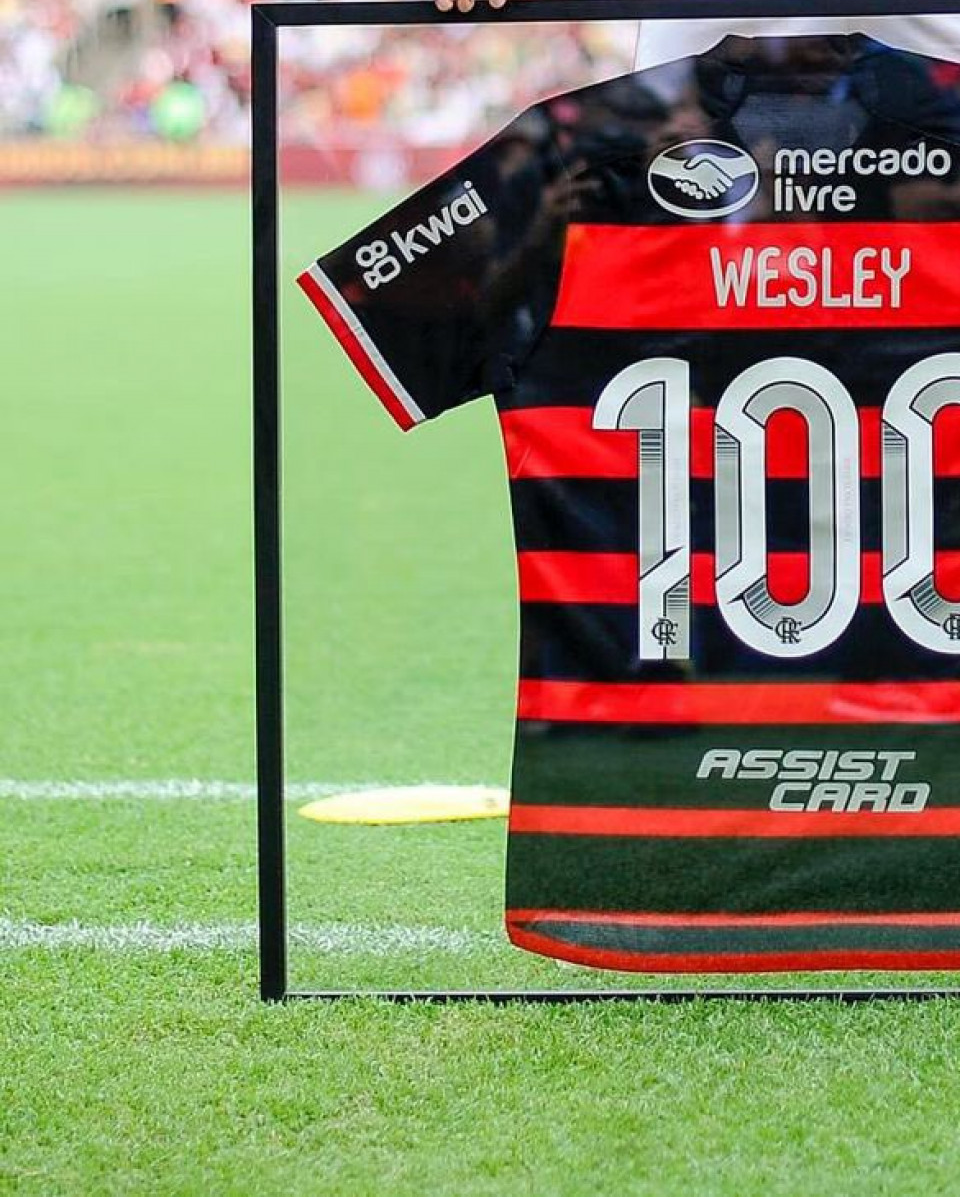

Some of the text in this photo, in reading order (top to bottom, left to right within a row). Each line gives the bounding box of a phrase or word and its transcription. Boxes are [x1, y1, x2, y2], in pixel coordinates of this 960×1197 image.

[774, 142, 952, 176] mercado
[774, 179, 856, 212] livre
[391, 180, 489, 264] kwai
[710, 246, 911, 309] WESLEY
[696, 749, 917, 780] ASSIST
[769, 782, 932, 813] CARD
